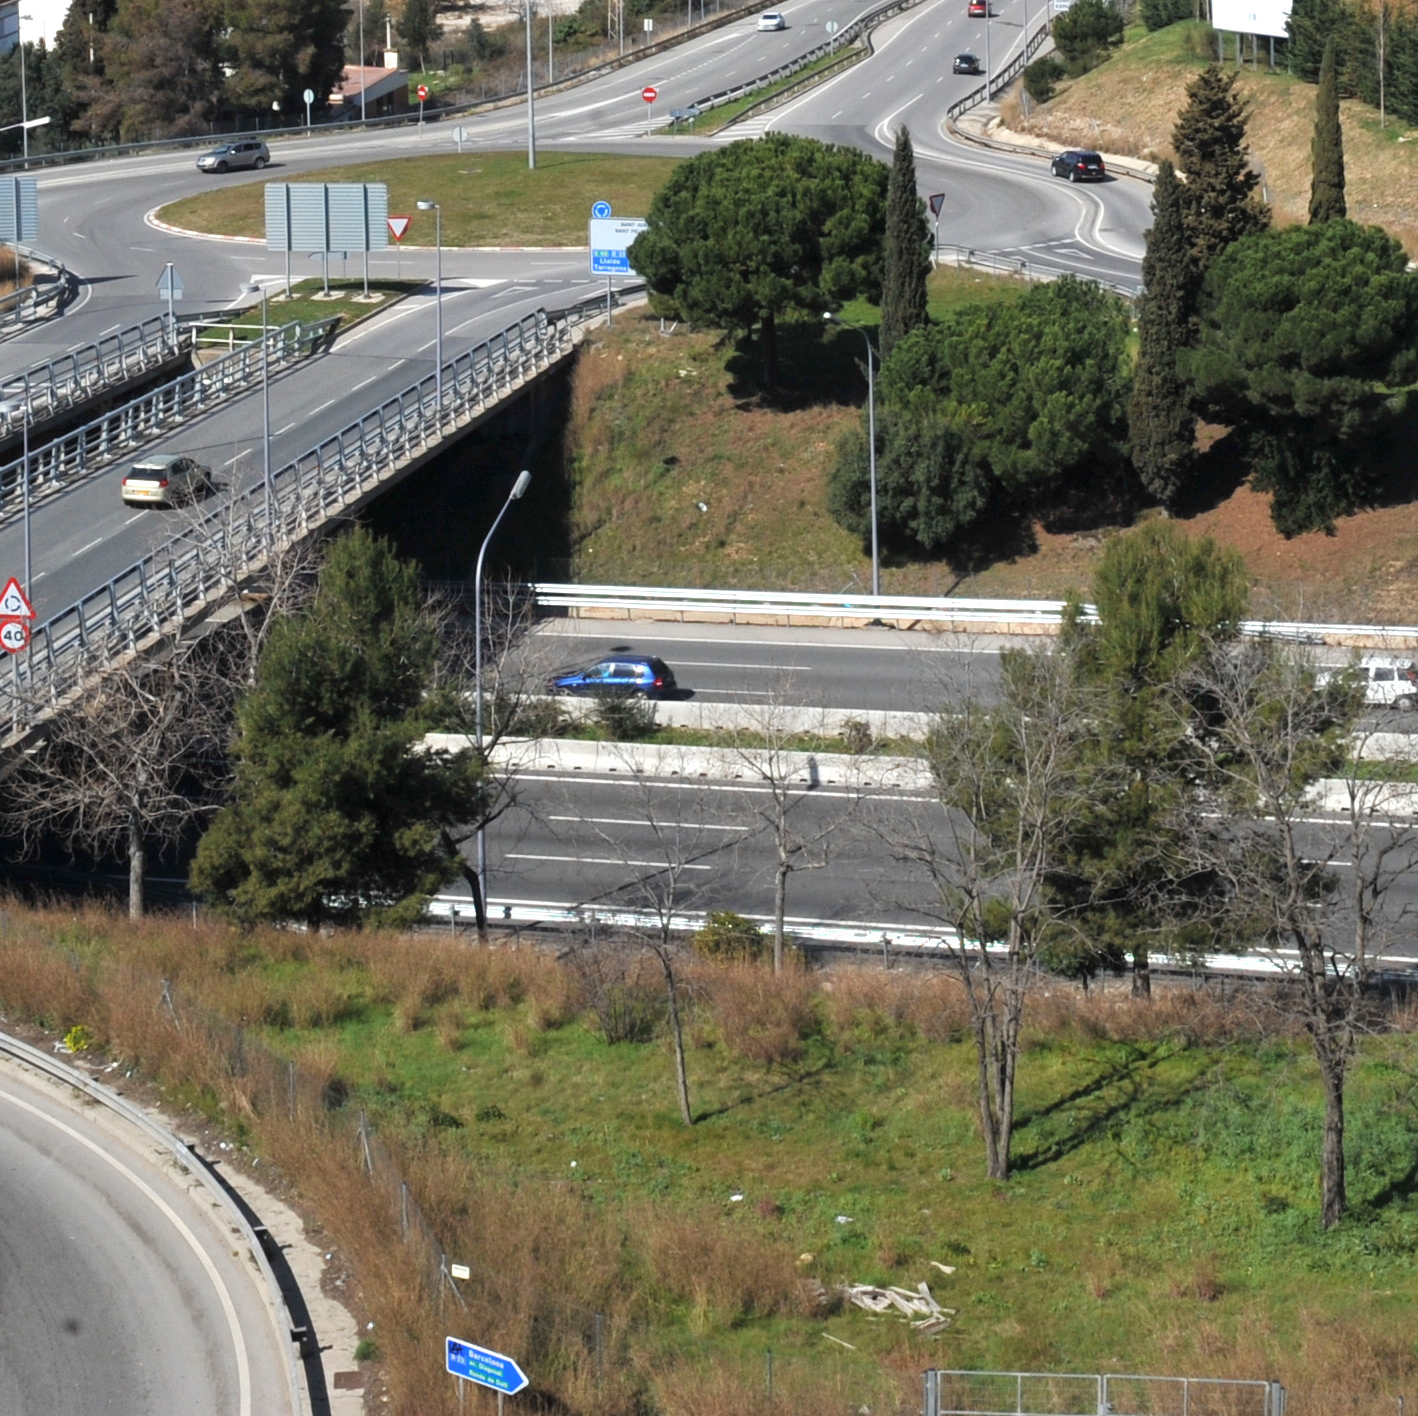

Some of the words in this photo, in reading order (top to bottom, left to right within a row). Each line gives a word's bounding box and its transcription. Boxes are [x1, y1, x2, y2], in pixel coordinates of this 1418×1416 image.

[594, 264, 627, 272] Tarragona
[4, 630, 23, 642] 40
[468, 1349, 504, 1369] Barcelona
[469, 1369, 486, 1381] Ronda
[487, 1376, 495, 1384] de
[478, 1362, 503, 1377] Diagonal
